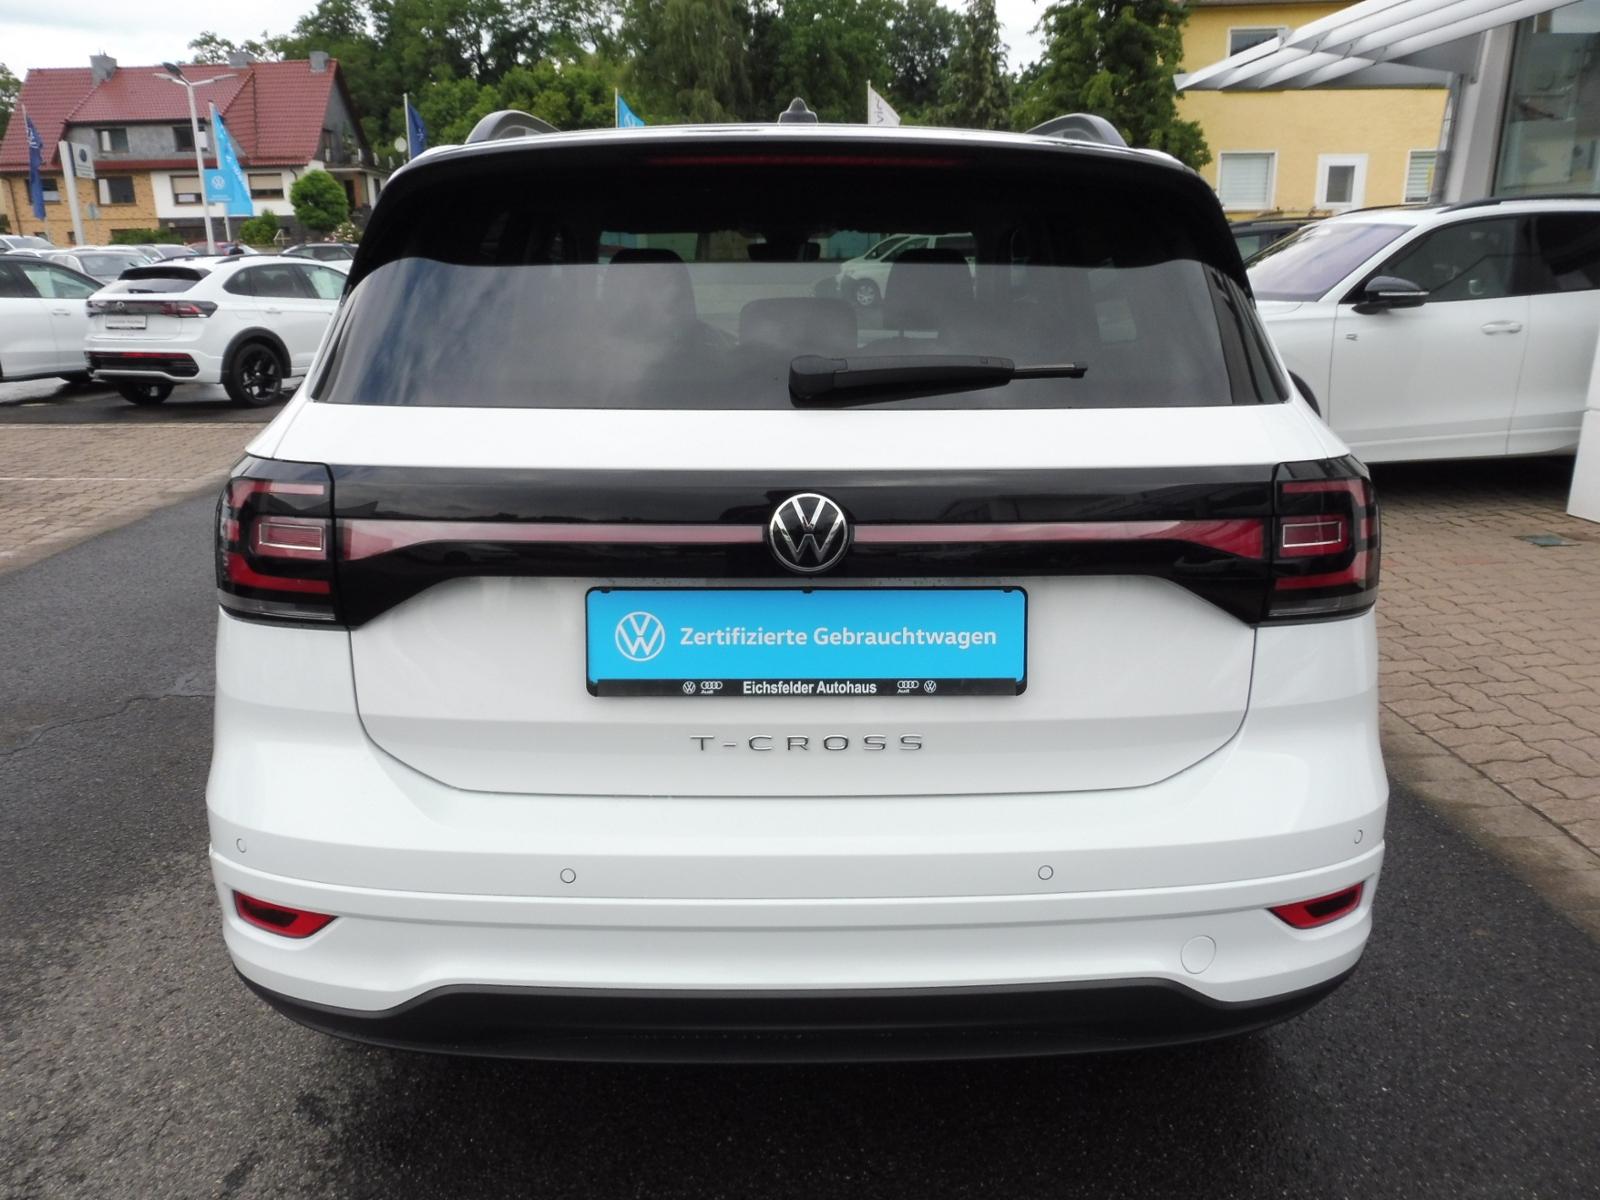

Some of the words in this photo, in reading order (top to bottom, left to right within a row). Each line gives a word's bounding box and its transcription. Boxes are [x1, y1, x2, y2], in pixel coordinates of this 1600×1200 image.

[679, 626, 808, 646] Zertifizierte
[813, 626, 997, 650] Gebrauchtwagen
[743, 681, 814, 694] Eichsfelder
[816, 681, 877, 694] Autohaus
[690, 733, 924, 751] T-CROSS
